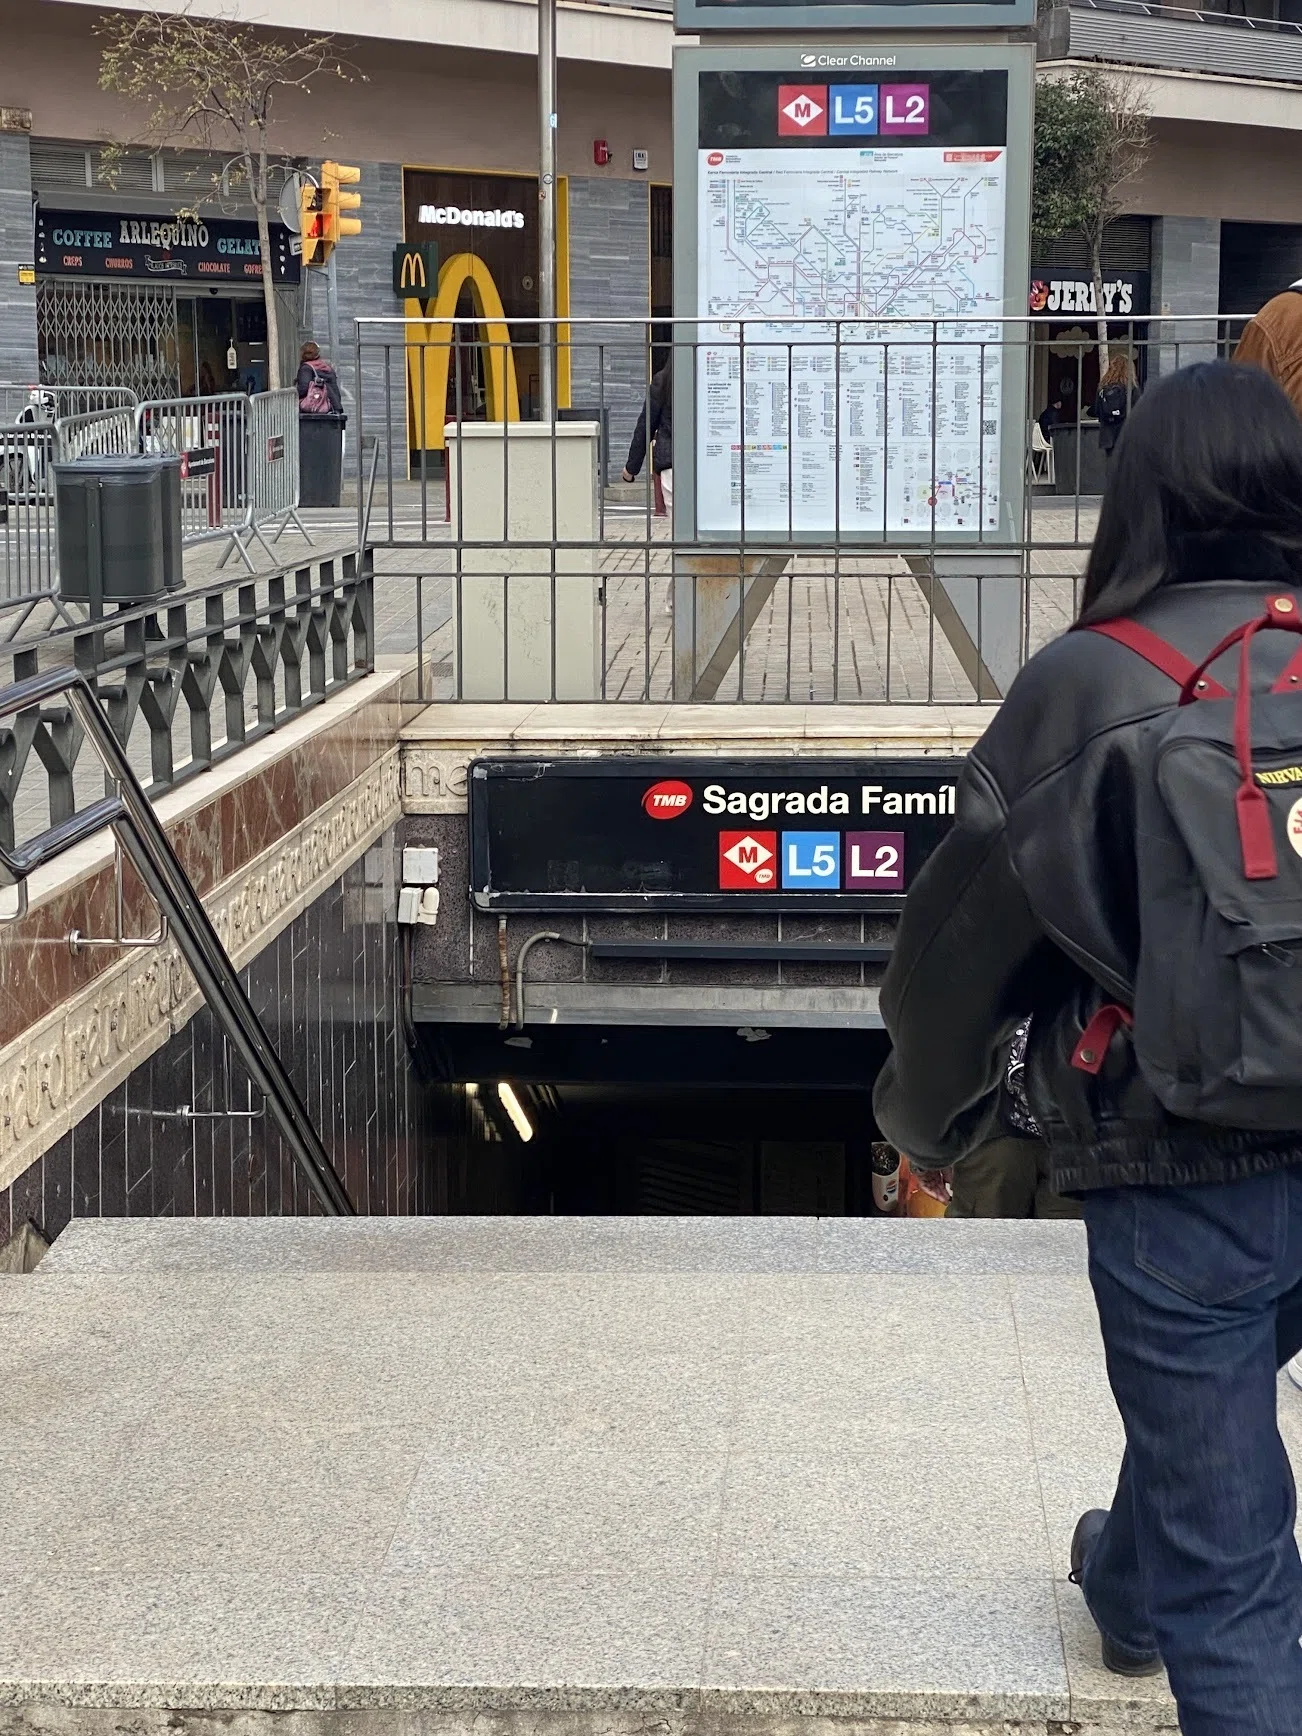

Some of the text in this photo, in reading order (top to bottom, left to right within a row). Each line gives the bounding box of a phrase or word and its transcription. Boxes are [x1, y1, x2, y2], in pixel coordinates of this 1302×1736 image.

[818, 55, 896, 66] Clear Channel
[794, 95, 925, 124] M L5 L2
[418, 205, 525, 229] McDonald's
[52, 220, 260, 255] COFFEE ARLEQUINO GELAT
[63, 255, 83, 267] CREPS
[105, 257, 133, 269] CHURROS
[198, 261, 231, 273] CHOCOLATE
[244, 263, 263, 275] GOFRE
[652, 784, 956, 821] TMB Sagrada Famíl
[738, 846, 758, 864] M
[788, 845, 836, 877] L5
[851, 845, 899, 877] L2
